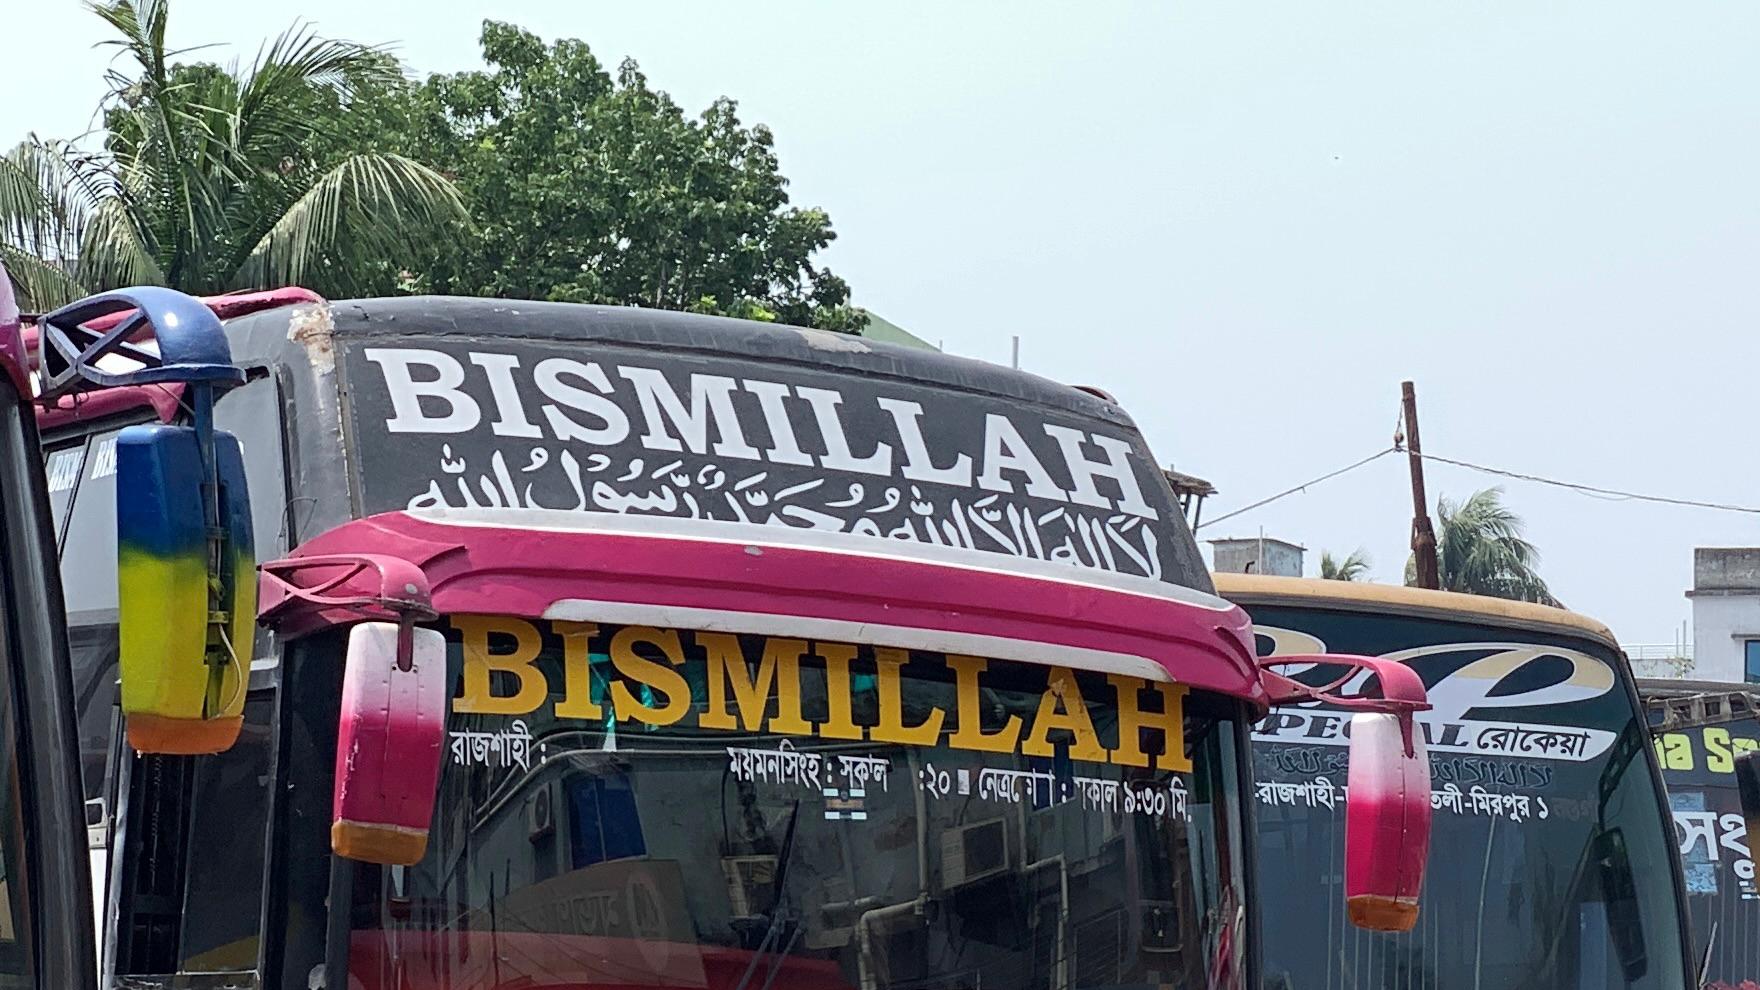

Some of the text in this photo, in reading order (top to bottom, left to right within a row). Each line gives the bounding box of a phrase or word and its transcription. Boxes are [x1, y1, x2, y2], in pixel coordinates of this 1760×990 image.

[364, 348, 1160, 521] BISMILLAH
[450, 614, 1194, 774] BISMILLAH
[1477, 726, 1592, 758] রোকেয়া
